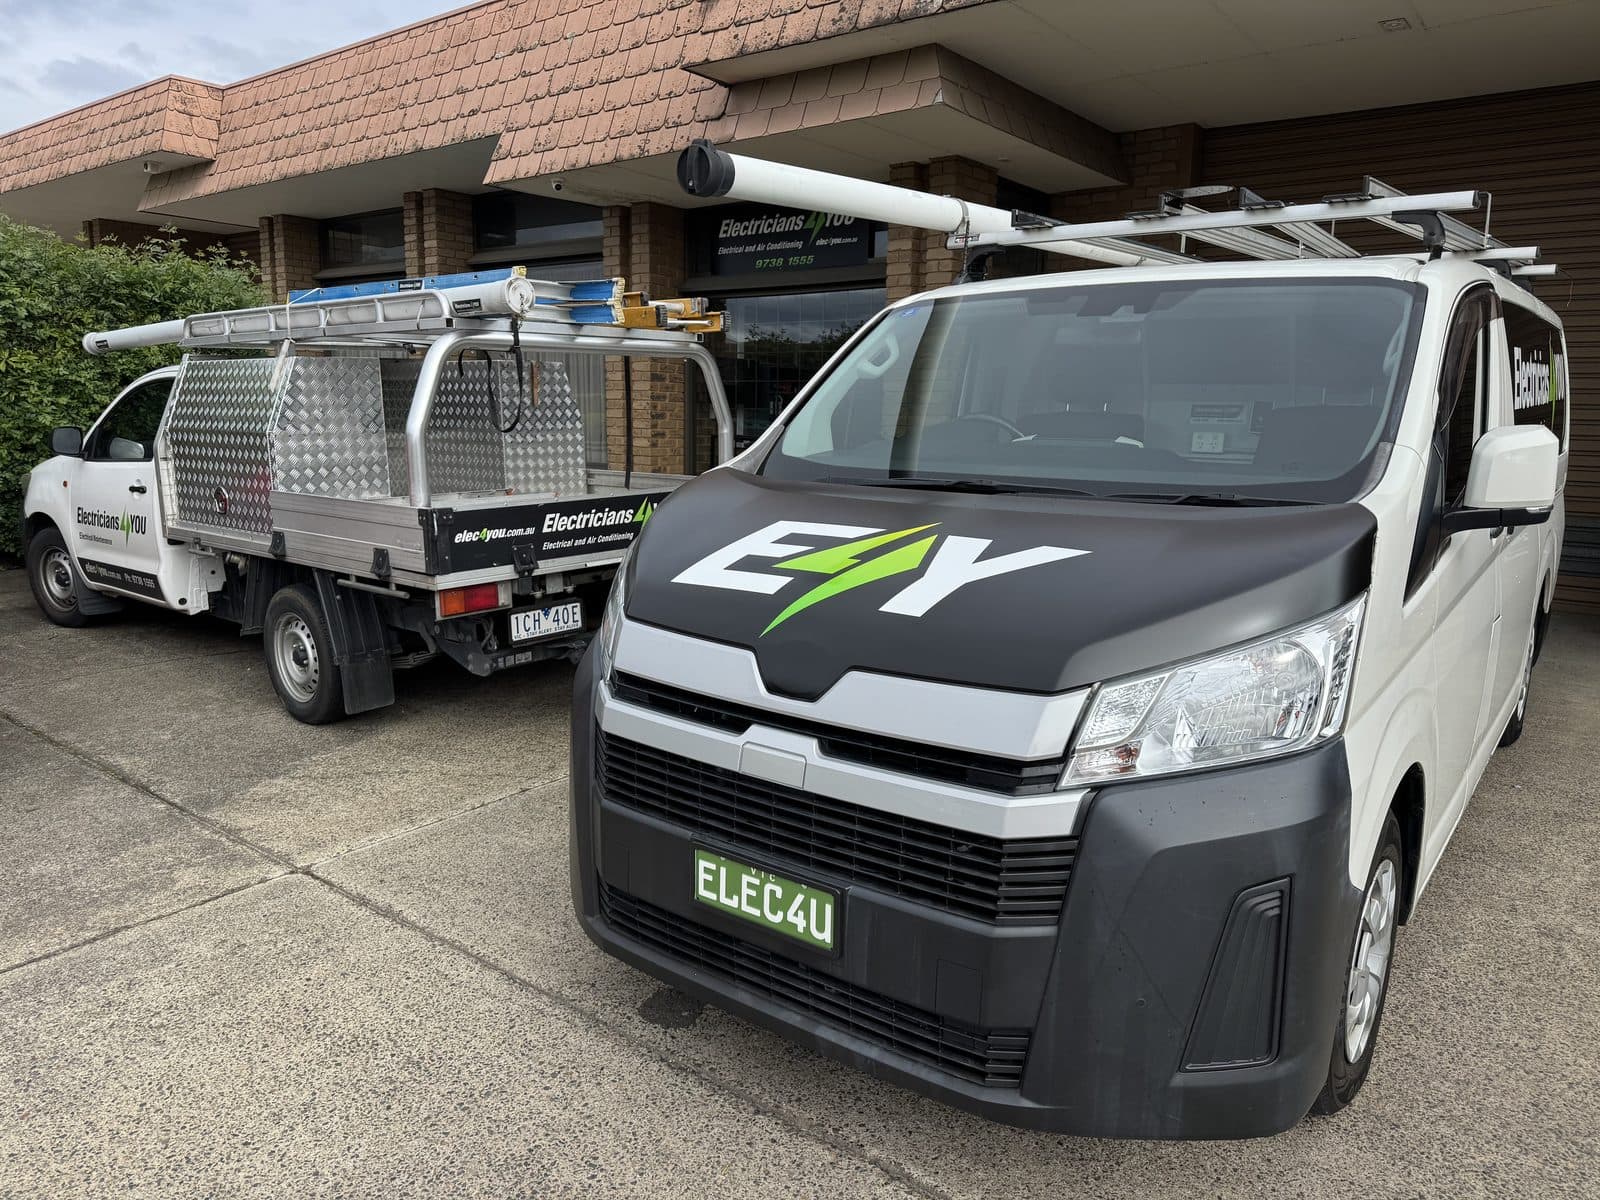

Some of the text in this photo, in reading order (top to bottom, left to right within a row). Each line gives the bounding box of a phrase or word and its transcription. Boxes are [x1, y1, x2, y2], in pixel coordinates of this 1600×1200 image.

[718, 240, 803, 255] Electrical and Air Conditioning
[755, 255, 814, 269] 9738 1555
[454, 527, 535, 543] elec4you.com.au
[542, 531, 634, 550] Electrical and Air Conditioning
[515, 612, 540, 634] 1CH
[750, 866, 776, 882] VIC
[698, 858, 832, 944] ELEC4U
